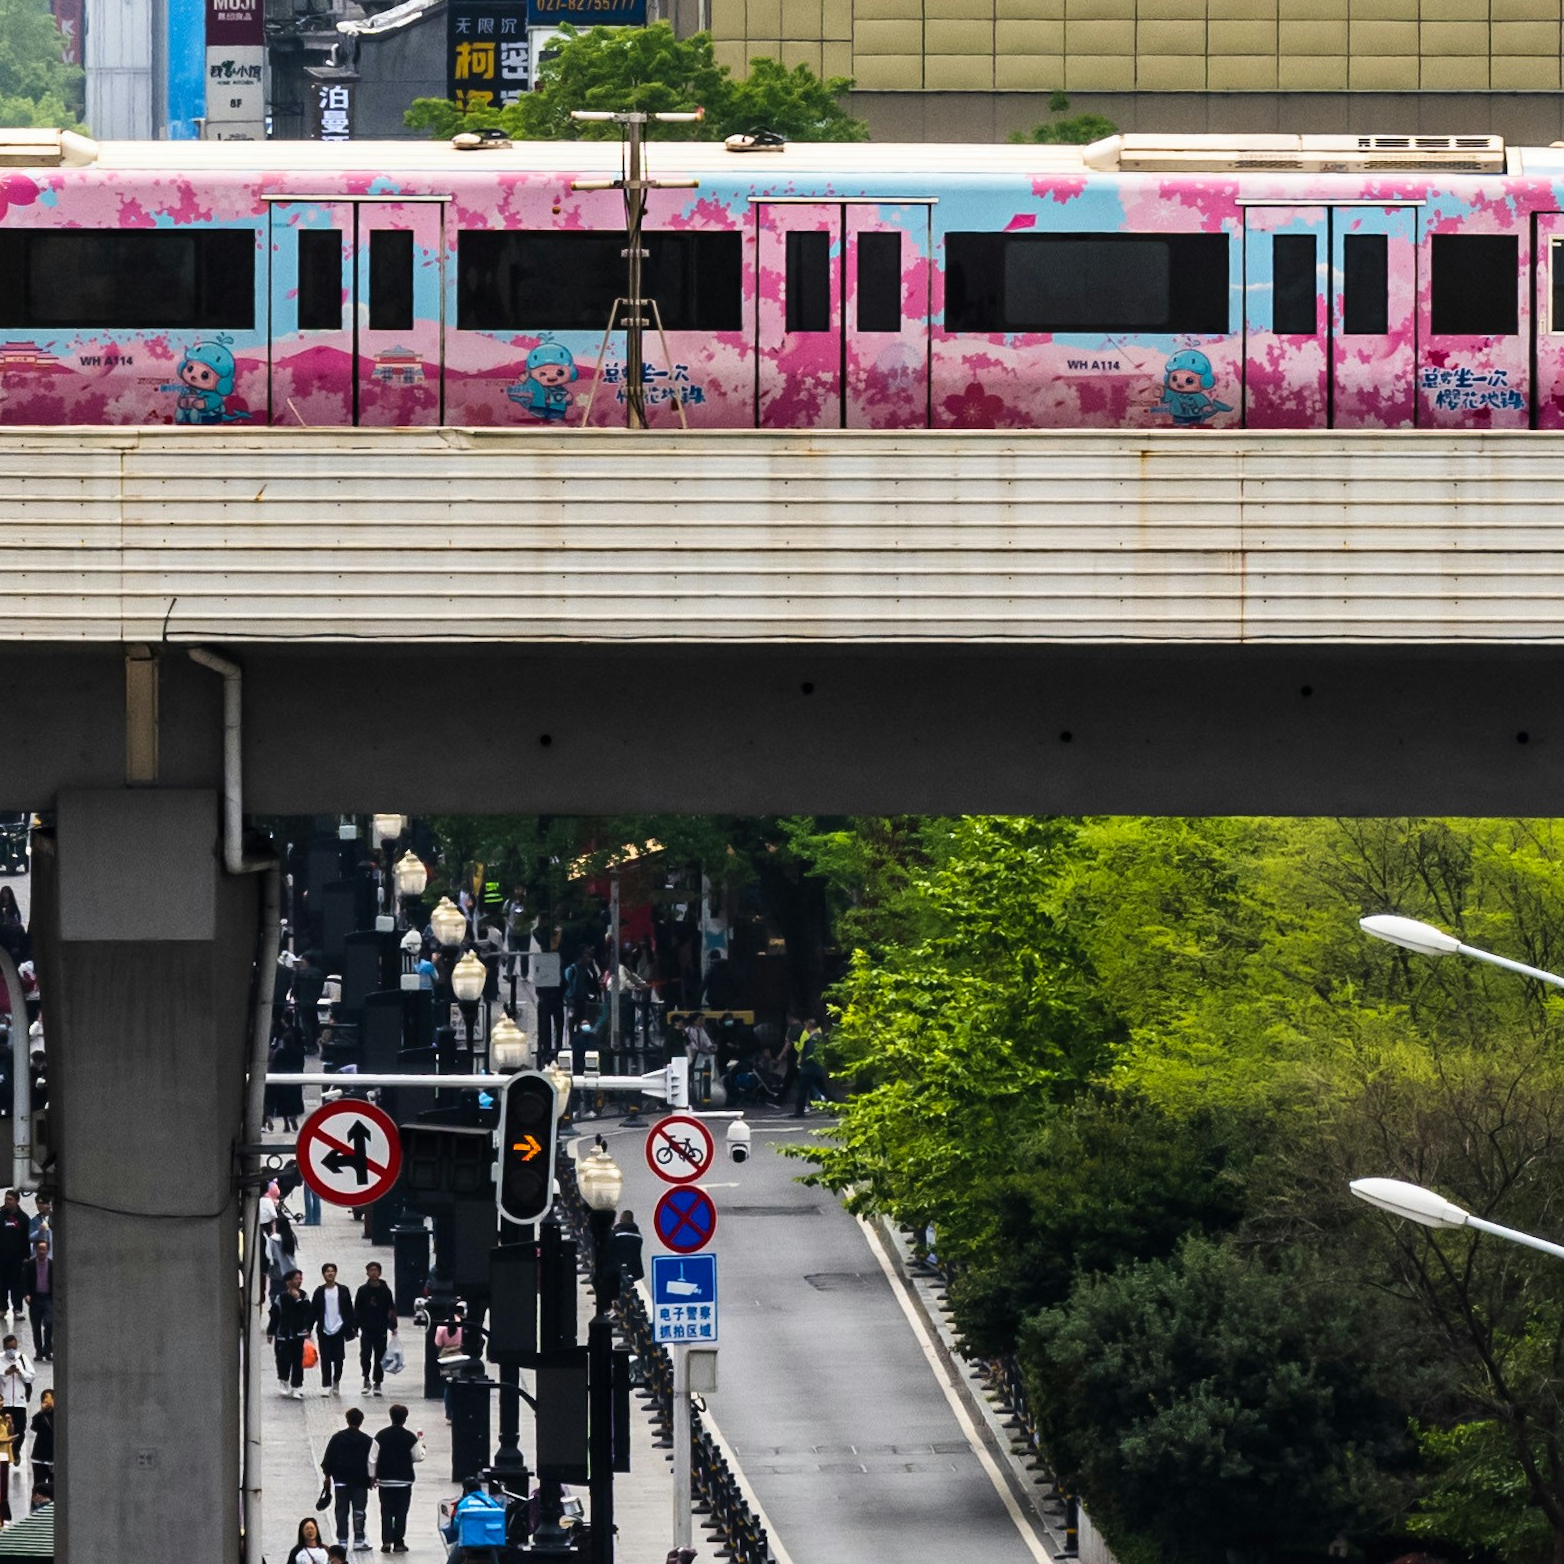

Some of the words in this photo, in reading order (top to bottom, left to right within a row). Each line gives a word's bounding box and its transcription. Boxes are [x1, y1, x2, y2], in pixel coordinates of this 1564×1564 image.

[456, 18, 528, 34] 无限沉
[319, 86, 349, 140] 泊曼
[80, 356, 101, 366] WH
[104, 356, 133, 366] A114
[1067, 360, 1090, 371] WH
[1092, 360, 1121, 371] A114
[659, 1307, 711, 1322] 电子警察
[659, 1323, 712, 1338] 抓拍区域
